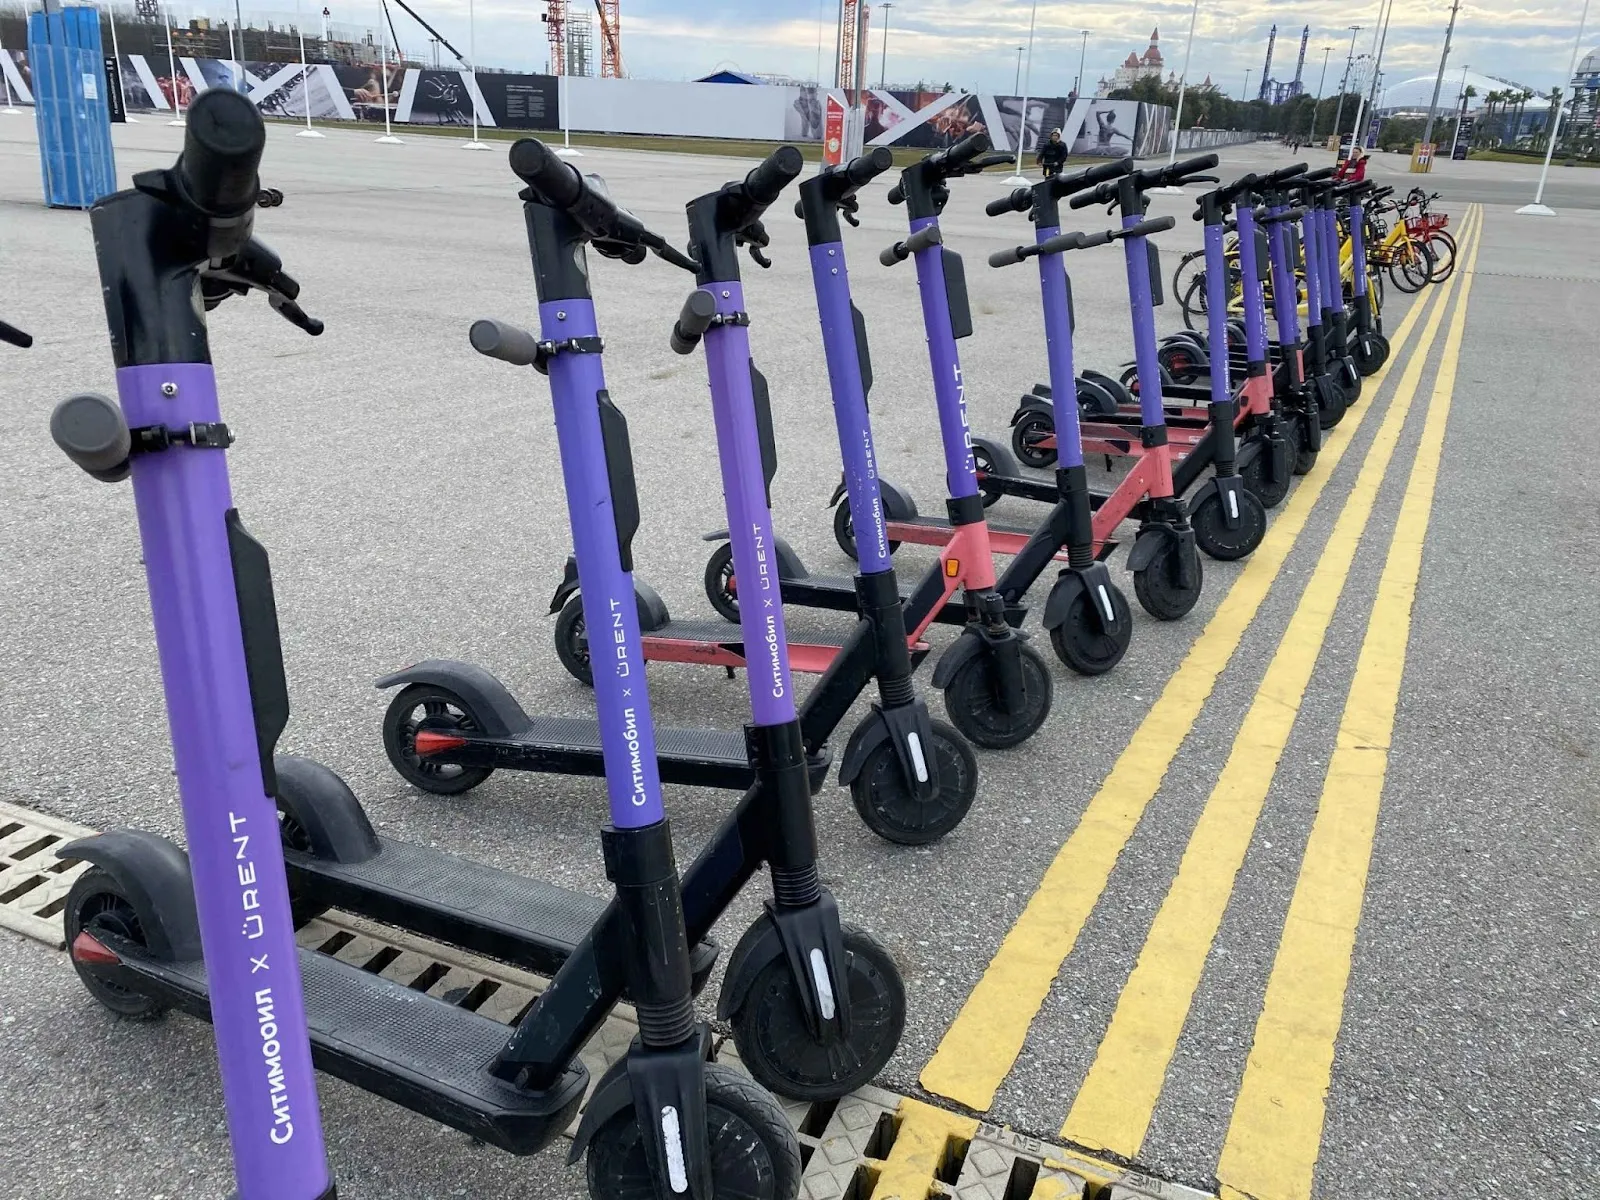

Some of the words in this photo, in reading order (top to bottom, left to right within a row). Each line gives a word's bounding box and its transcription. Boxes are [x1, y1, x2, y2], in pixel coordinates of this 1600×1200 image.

[863, 429, 875, 479] ÜRENT
[752, 523, 770, 590] ÜRENT
[872, 498, 887, 559] Ситимобил
[610, 598, 630, 678] ÜRENT
[765, 615, 784, 698] Ситимобил
[623, 707, 646, 807] Ситимобил
[228, 811, 264, 940] ÜRENT
